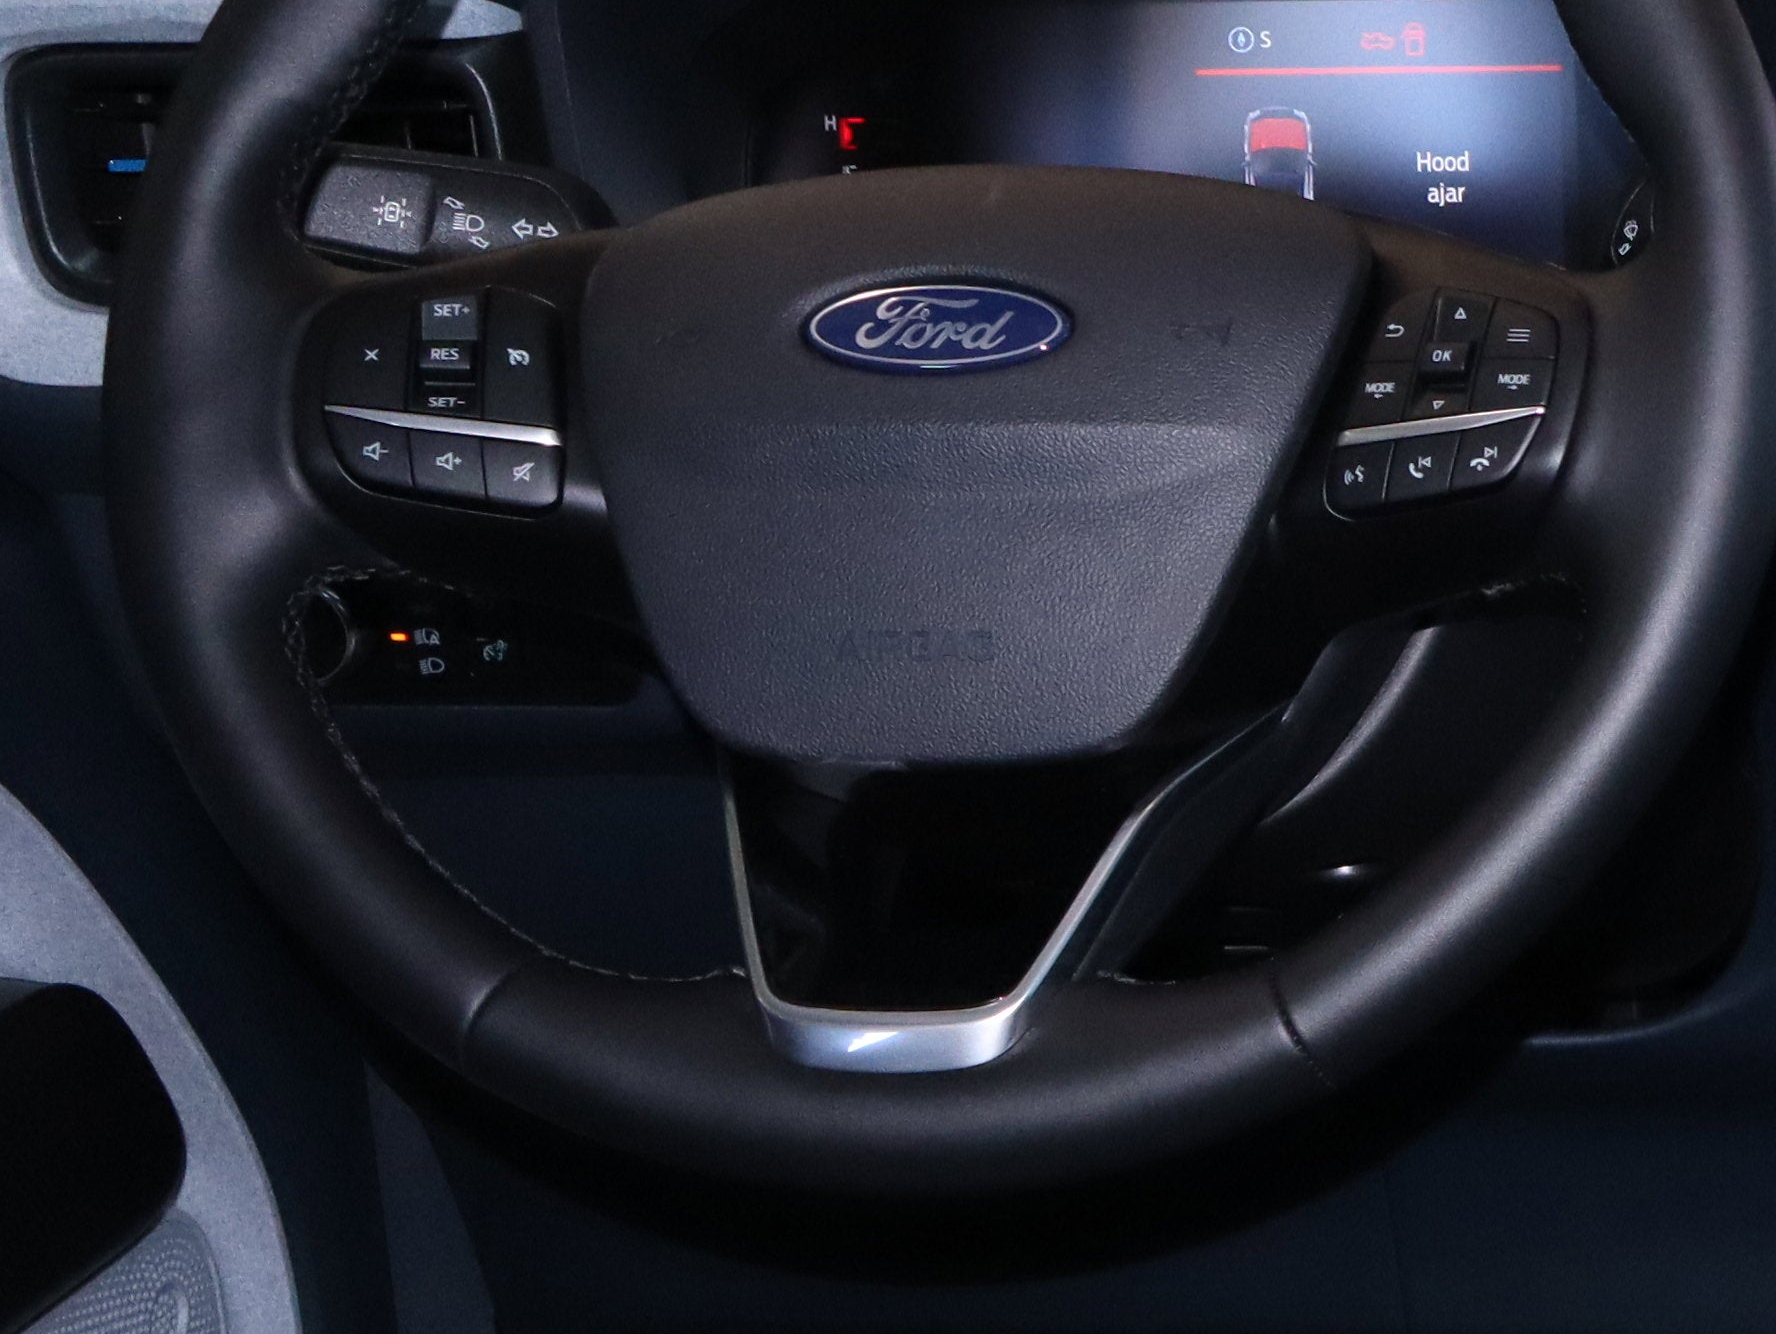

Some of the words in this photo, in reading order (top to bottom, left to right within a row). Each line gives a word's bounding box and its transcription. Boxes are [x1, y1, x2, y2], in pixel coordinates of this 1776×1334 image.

[1259, 31, 1272, 49] S
[823, 115, 838, 131] H
[1416, 150, 1471, 174] Hood
[1427, 180, 1466, 207] ajar
[433, 303, 470, 317] SET+
[855, 296, 1013, 351] Ford
[430, 347, 460, 361] RES
[1432, 350, 1453, 363] OK
[1498, 373, 1531, 386] MODE
[1365, 382, 1396, 394] MODE
[428, 396, 466, 408] SET-
